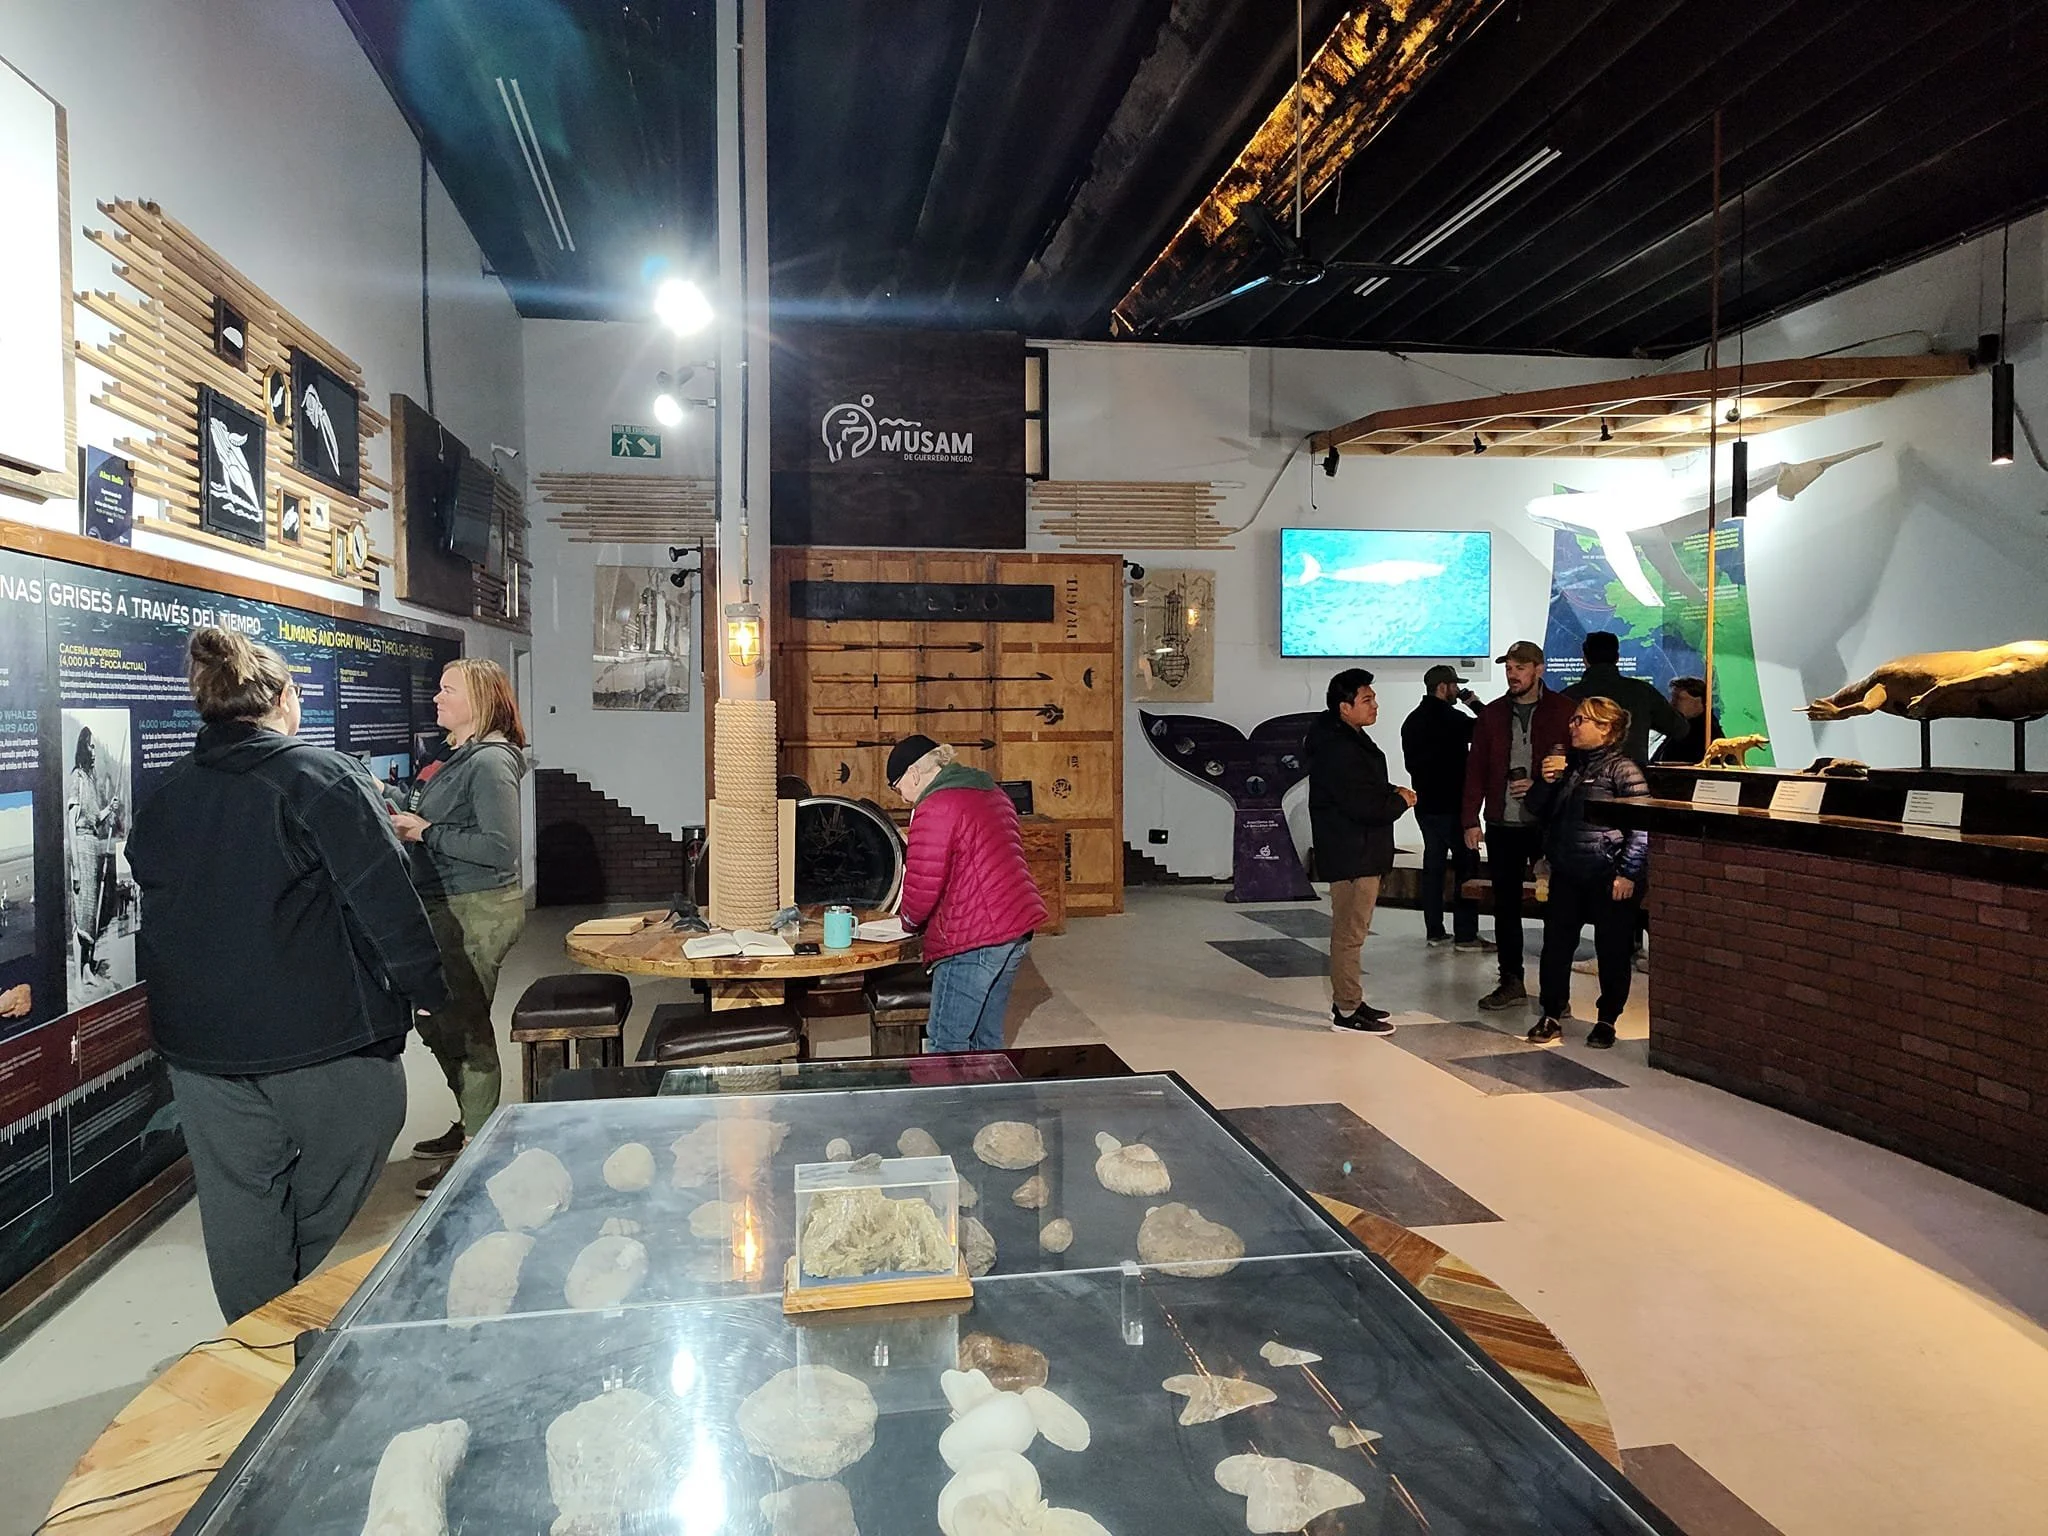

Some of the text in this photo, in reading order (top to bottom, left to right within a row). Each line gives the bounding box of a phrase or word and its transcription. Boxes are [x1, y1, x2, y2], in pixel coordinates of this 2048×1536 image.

[881, 430, 973, 454] MUSAM
[914, 454, 949, 462] GUERRERO
[950, 455, 973, 463] NEGRO
[49, 583, 113, 614] GRISES
[116, 595, 128, 616] A
[131, 598, 190, 625] TRAVÉS
[192, 607, 219, 629] DEL
[218, 610, 261, 636] TIEMPO
[279, 619, 318, 645] HUMANS
[318, 630, 335, 648] AND
[335, 631, 355, 649] GRAY
[355, 634, 381, 653] WHALES
[5, 711, 38, 720] WHALES
